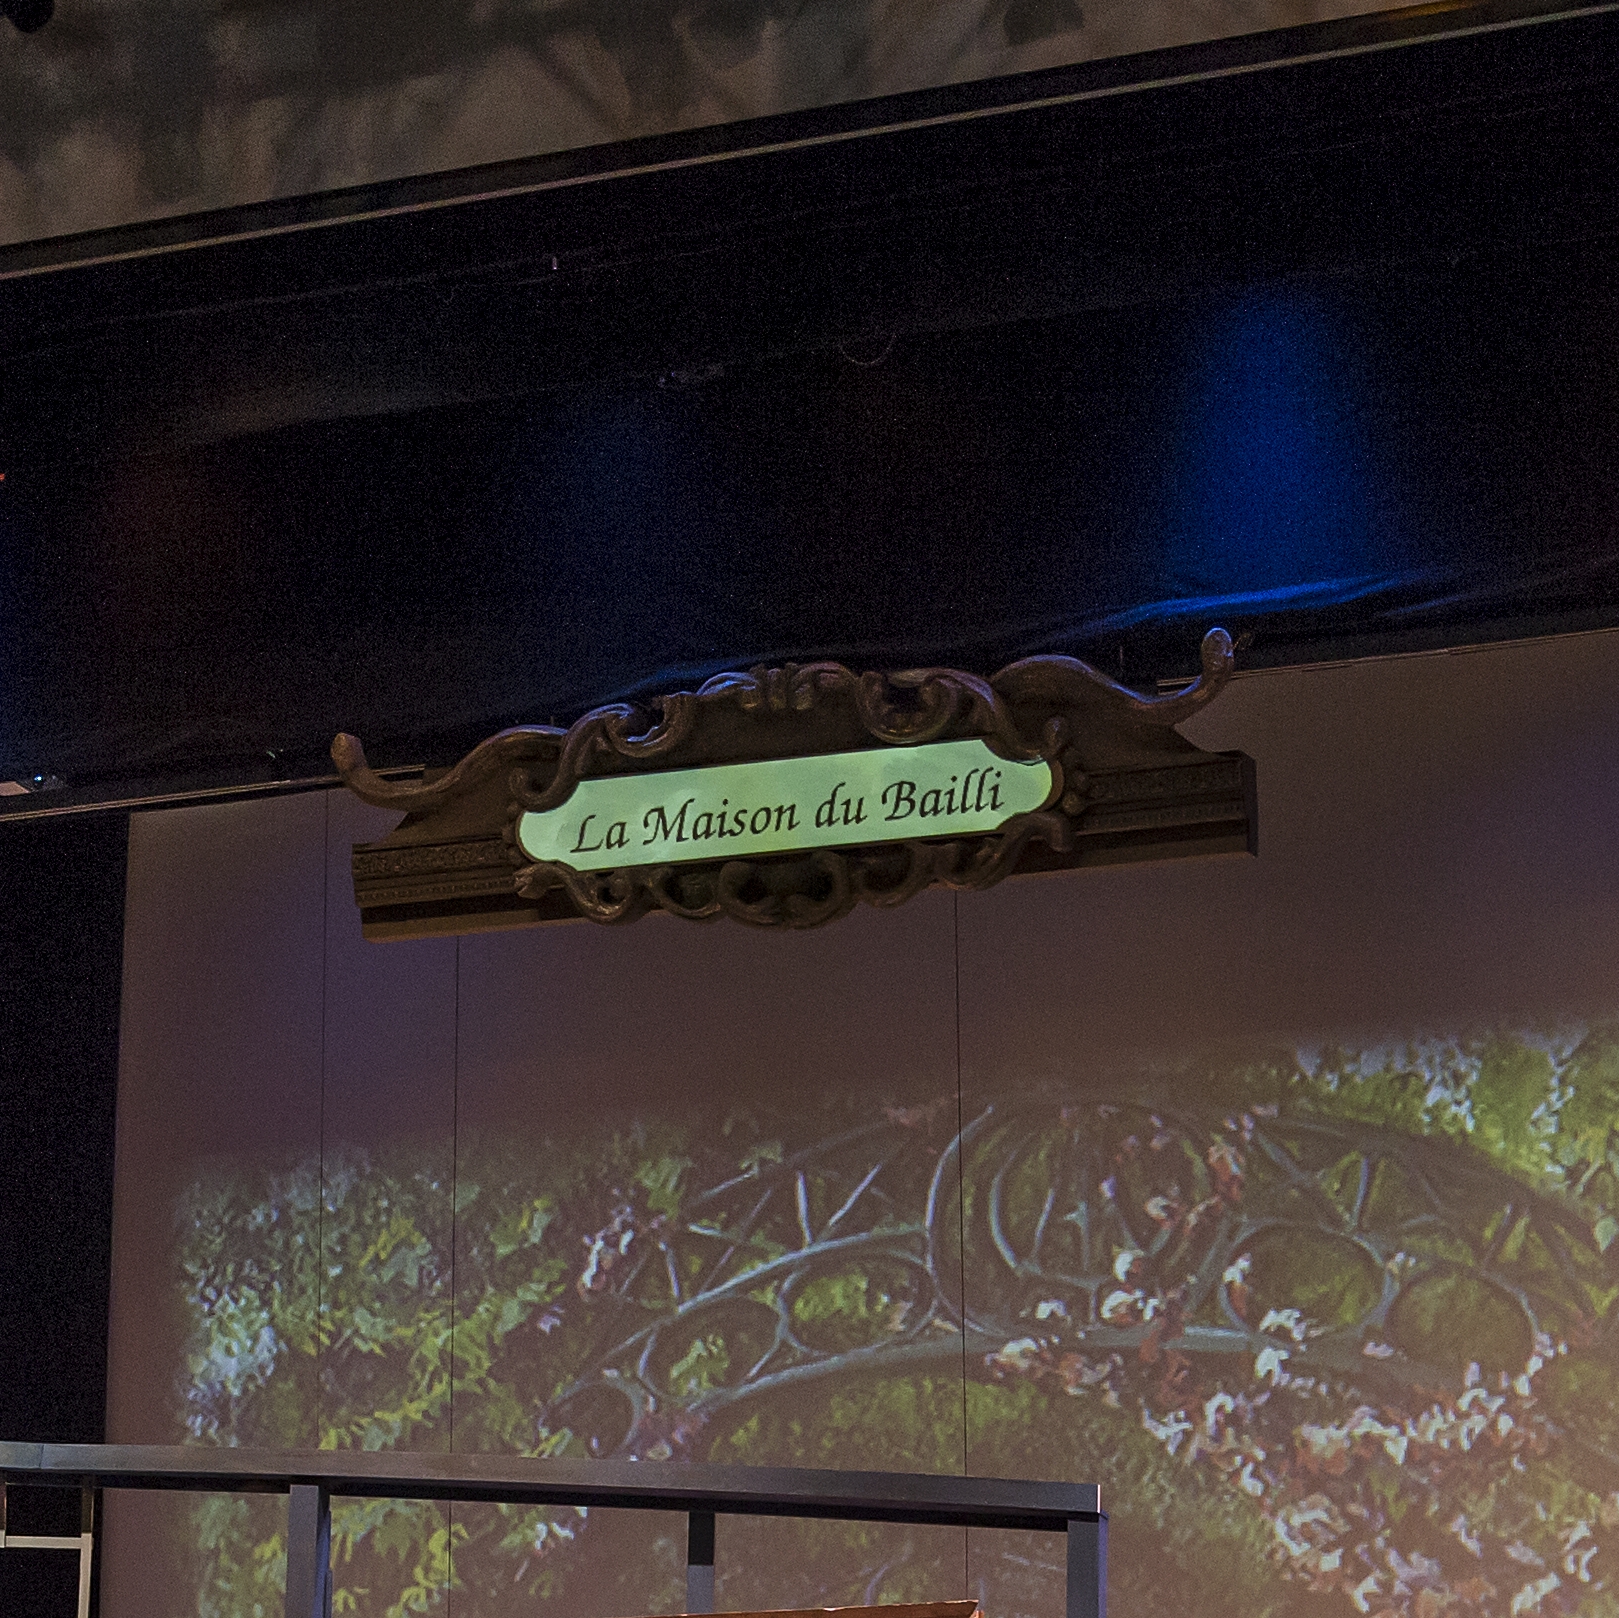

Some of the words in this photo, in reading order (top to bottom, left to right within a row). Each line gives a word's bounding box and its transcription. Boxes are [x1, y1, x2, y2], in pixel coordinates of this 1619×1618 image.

[570, 815, 629, 853] La
[643, 798, 800, 845] Maison
[814, 782, 867, 828] du
[882, 767, 1004, 821] Bailli
